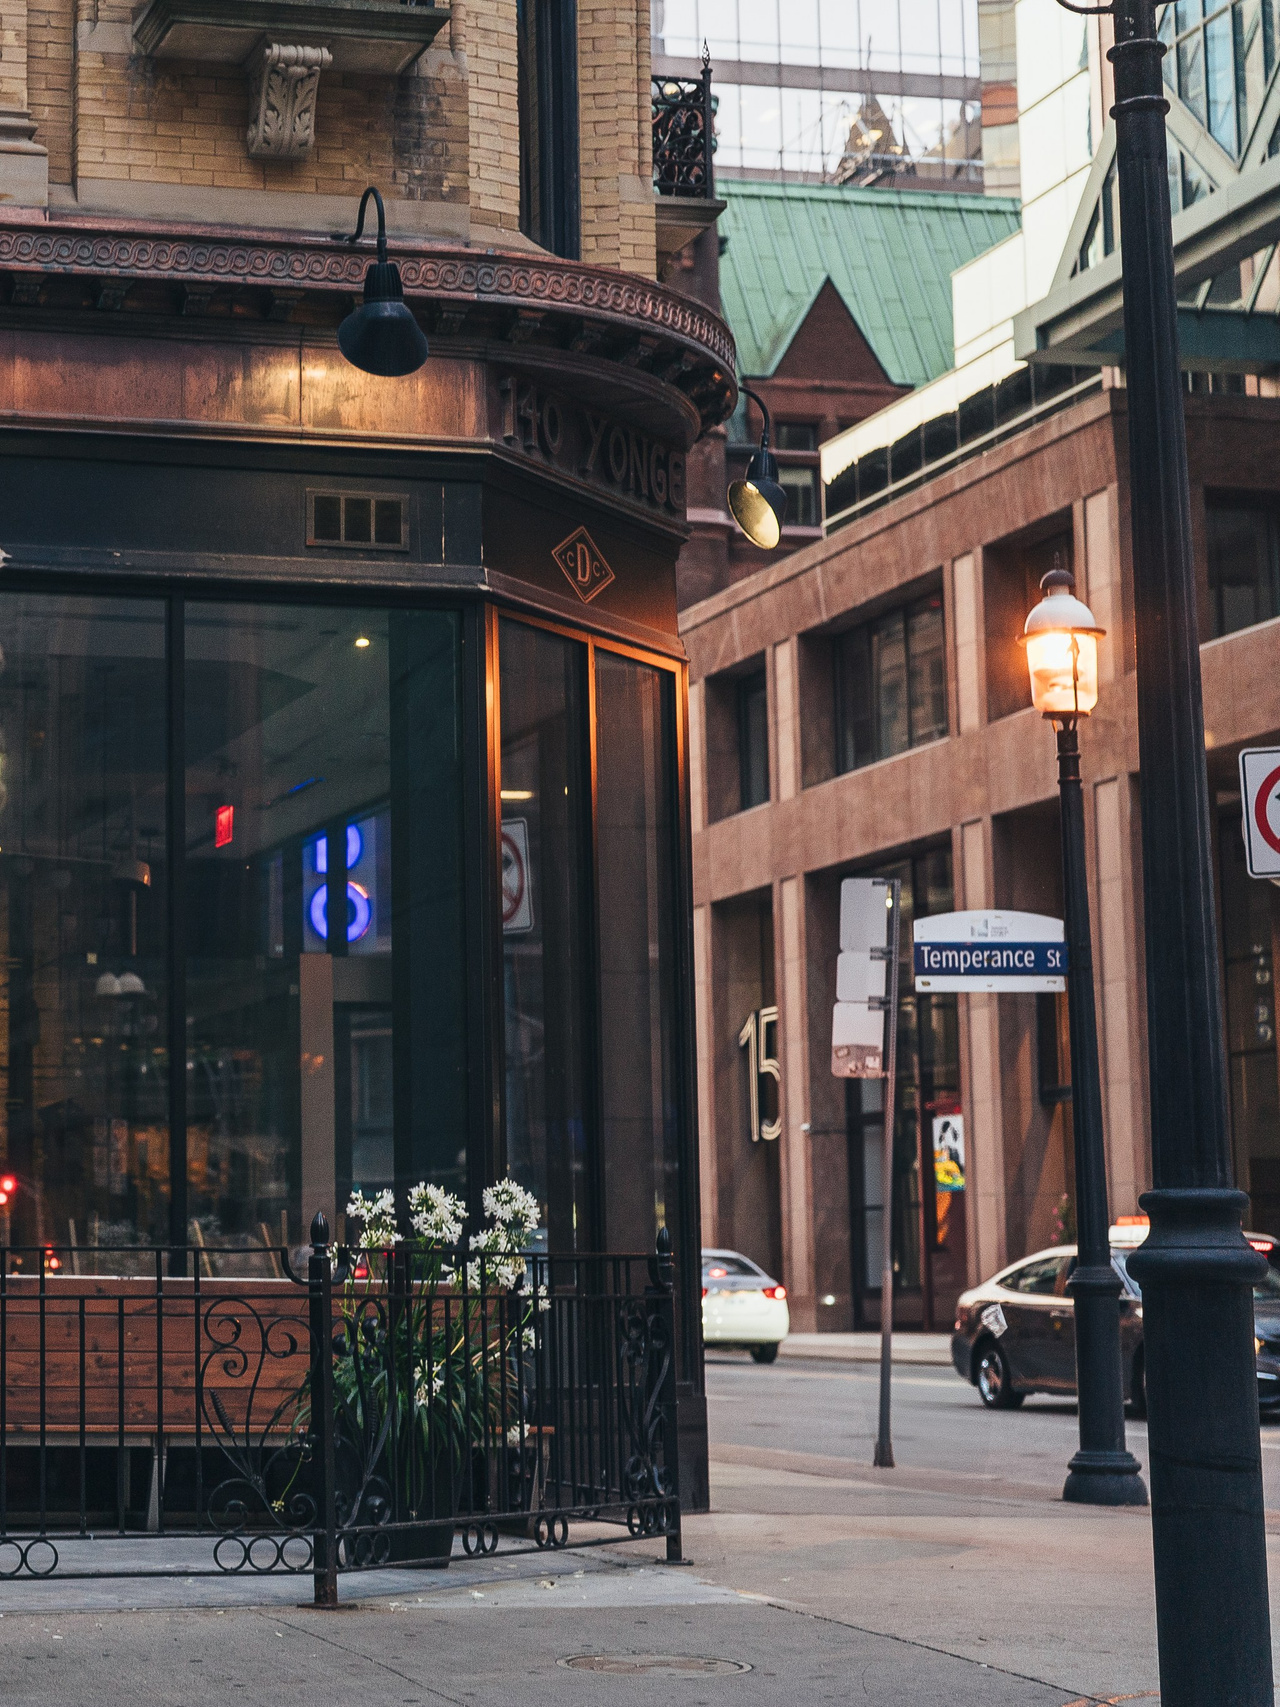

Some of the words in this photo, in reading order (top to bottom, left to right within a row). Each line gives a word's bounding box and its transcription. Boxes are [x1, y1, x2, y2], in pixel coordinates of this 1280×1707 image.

[500, 376, 563, 454] 140
[584, 409, 686, 513] YONGE
[920, 945, 1035, 974] Temperance
[1046, 949, 1062, 969] St
[738, 1005, 782, 1143] 15
